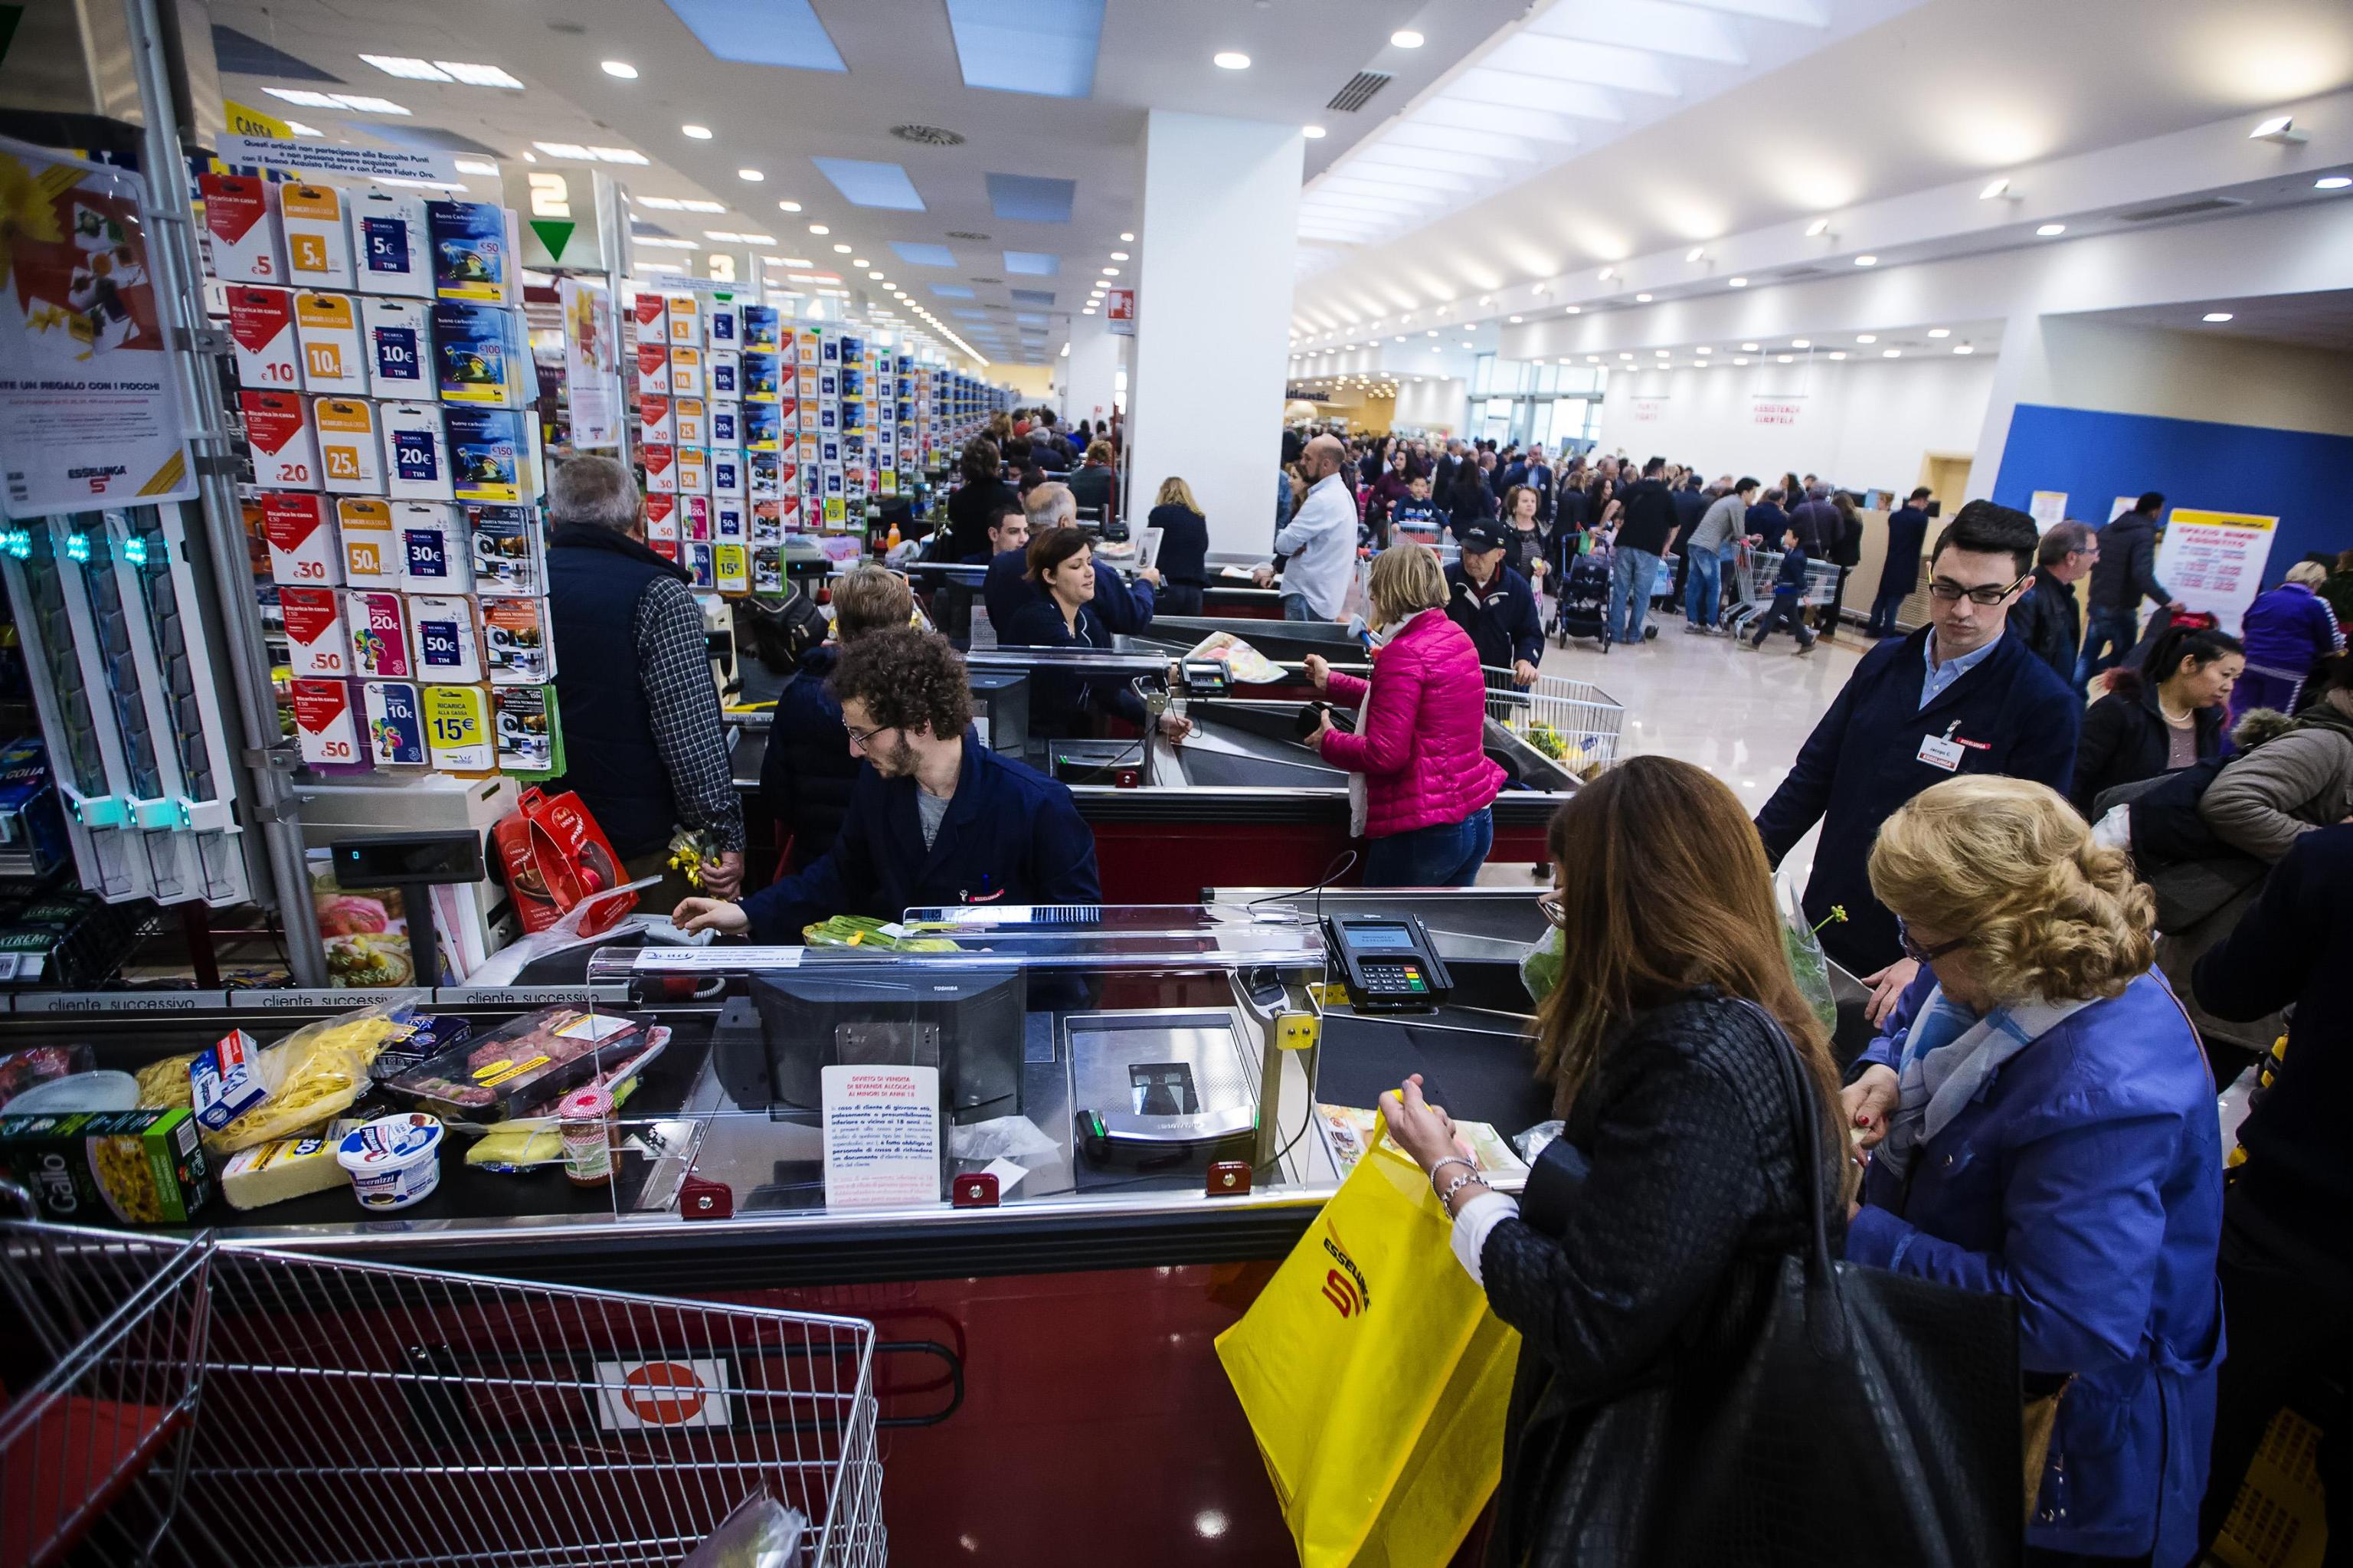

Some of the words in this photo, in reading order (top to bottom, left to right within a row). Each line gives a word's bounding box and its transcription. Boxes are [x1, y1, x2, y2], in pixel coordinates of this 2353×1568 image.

[235, 116, 273, 139] CASSA
[244, 139, 268, 148] Questi
[270, 142, 296, 152] articoli
[315, 147, 360, 158] partecipano
[378, 152, 409, 162] Raccolta
[411, 155, 429, 163] Punti
[265, 156, 289, 165] Buono
[291, 159, 322, 169] Acquisto
[372, 166, 391, 175] Carta
[303, 154, 335, 162] possono
[362, 159, 398, 169] acquistati
[529, 172, 571, 218] 2
[374, 237, 395, 255] 5€
[480, 242, 499, 253] €50
[303, 241, 322, 267] 5€
[251, 255, 273, 275] €5
[709, 254, 735, 282] 3
[382, 346, 414, 363] 10€
[479, 345, 501, 355] €100
[311, 350, 340, 373] 10€
[261, 363, 295, 383] €10
[717, 374, 731, 384] 10€
[20, 381, 38, 390] UN
[41, 381, 85, 390] REGALO
[88, 382, 111, 390] CON
[114, 382, 118, 390] I
[120, 382, 160, 390] FIOCCHI
[717, 422, 731, 432] 20€
[400, 448, 432, 465] 20€
[492, 446, 512, 456] €150
[330, 453, 358, 475] 25€
[68, 465, 127, 479] ESSELUNGA
[276, 464, 308, 482] €20
[718, 472, 733, 481] 30€
[722, 519, 737, 528] 50€
[352, 549, 380, 570] 50€
[411, 546, 442, 562] 30€
[293, 561, 326, 579] €30
[720, 563, 740, 575] 15€
[372, 616, 399, 630] 20€
[427, 637, 456, 651] 50€
[311, 653, 341, 670] €50
[388, 705, 413, 719] 10€
[433, 718, 475, 740] 15€
[321, 742, 350, 758] €50
[1960, 738, 1986, 749] ESSELUNGA
[1923, 754, 1951, 767] ESSELUNGA
[6, 766, 45, 780] GOLIA
[974, 893, 1000, 902] ESSELUNGA
[49, 997, 101, 1011] cliente
[111, 997, 195, 1010] successivo
[263, 994, 313, 1007] cliente
[466, 991, 514, 1003] cliente
[523, 990, 600, 1003] successivo
[41, 1154, 77, 1213] Gallo
[358, 1175, 394, 1185] invernizzi
[1323, 1237, 1371, 1312] ESSELUNGA
